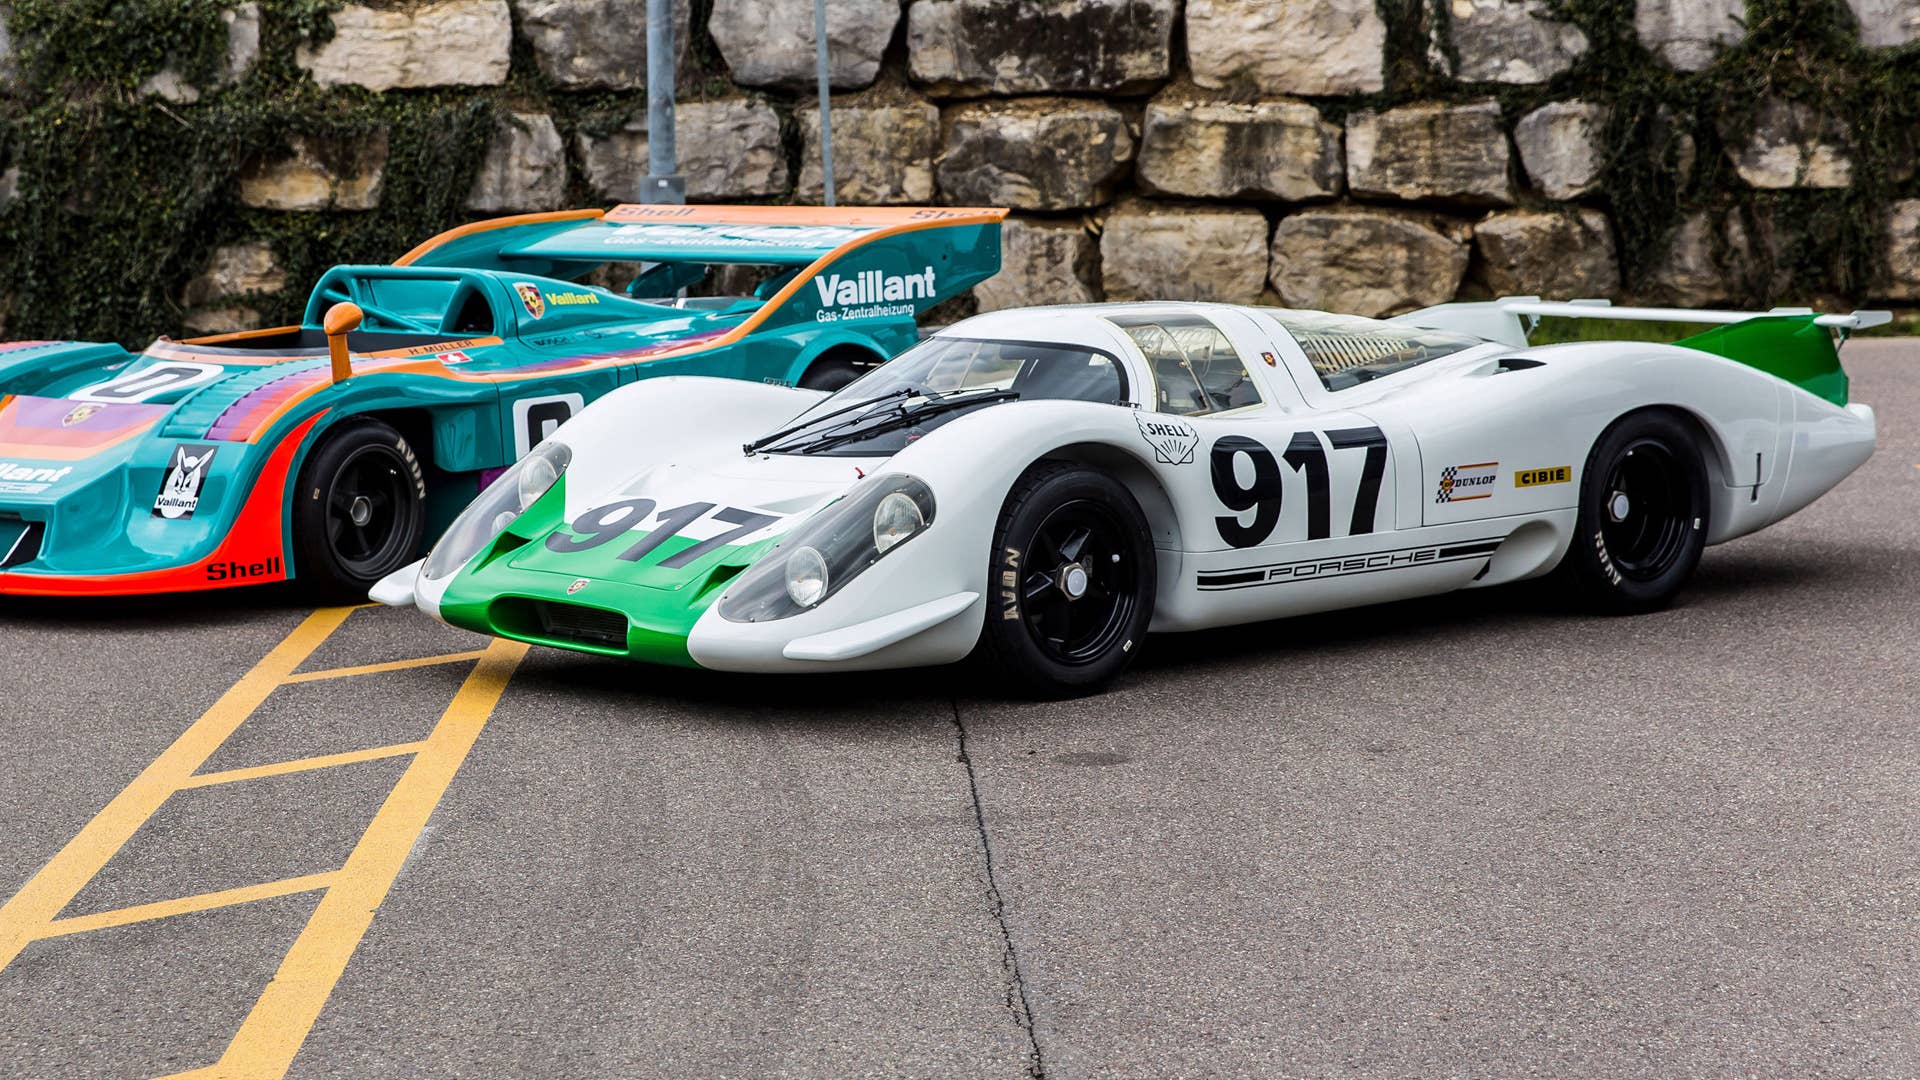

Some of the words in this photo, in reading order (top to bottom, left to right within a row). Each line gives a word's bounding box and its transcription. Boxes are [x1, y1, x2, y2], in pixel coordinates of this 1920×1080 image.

[614, 207, 697, 217] Shell
[815, 266, 936, 307] Vaillant
[546, 292, 599, 306] Vaillant
[816, 304, 915, 323] Gas-Zentralheizung
[90, 367, 203, 398] 0
[1147, 422, 1189, 437] SHELL
[1455, 475, 1497, 487] DUNLOP
[1521, 468, 1565, 484] CIBIE
[1210, 426, 1387, 549] 917
[157, 496, 196, 508] Vaillant
[545, 499, 783, 569] 917
[207, 557, 279, 580] Shell
[1269, 550, 1436, 580] PORSCHE
[1002, 548, 1021, 620] AVON
